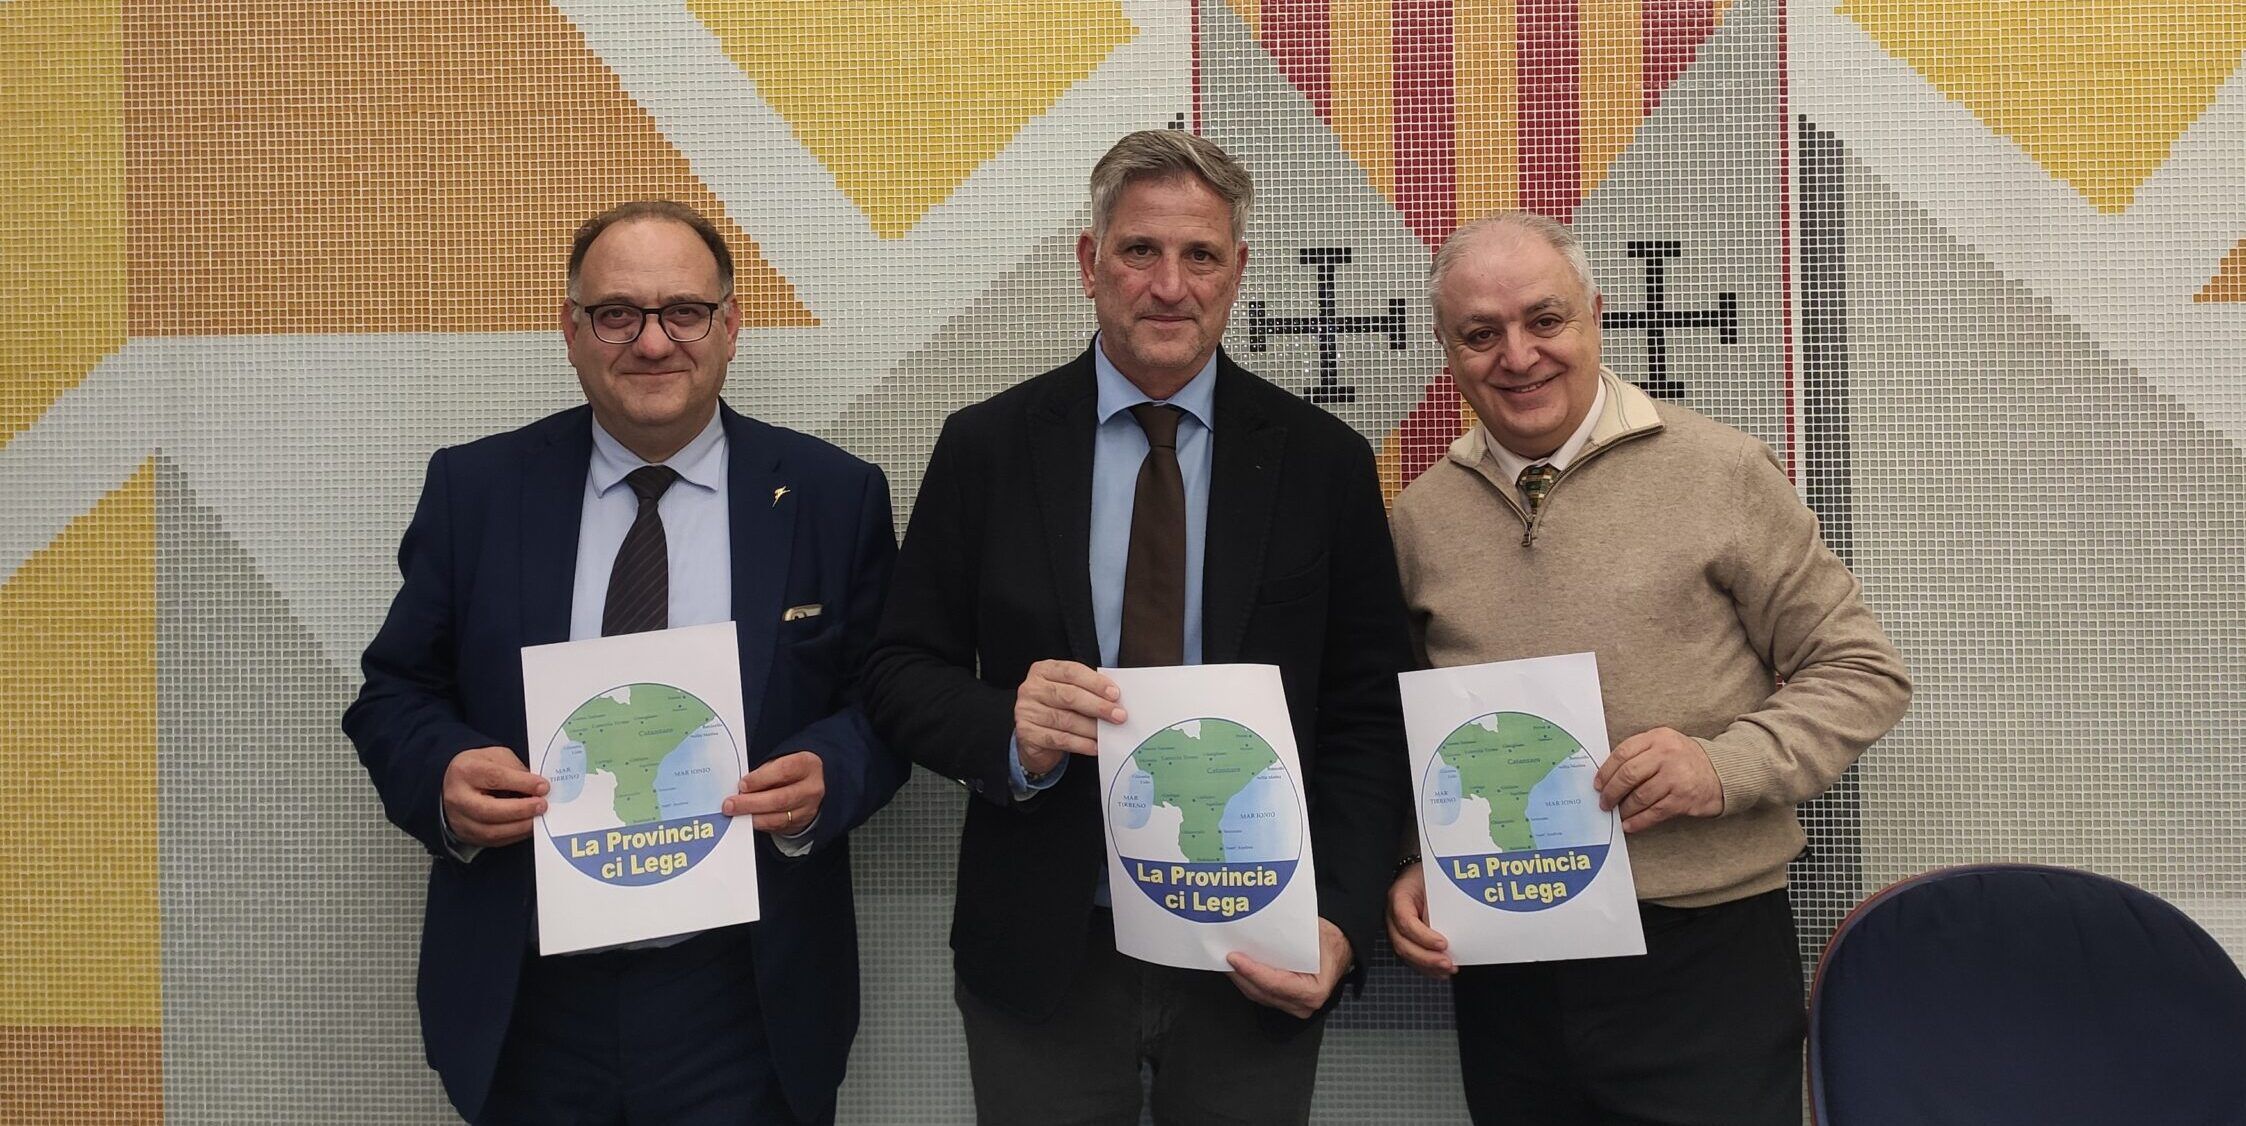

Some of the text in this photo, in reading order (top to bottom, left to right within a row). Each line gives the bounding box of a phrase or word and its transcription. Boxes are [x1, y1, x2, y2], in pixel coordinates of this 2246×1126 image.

[571, 820, 714, 858] La Provincia
[601, 851, 688, 879] ci Lega
[1137, 863, 1278, 887] La Provincia
[1453, 851, 1591, 880] La Provincia
[1165, 891, 1250, 917] ci Lega
[1484, 881, 1568, 903] ci Lega
